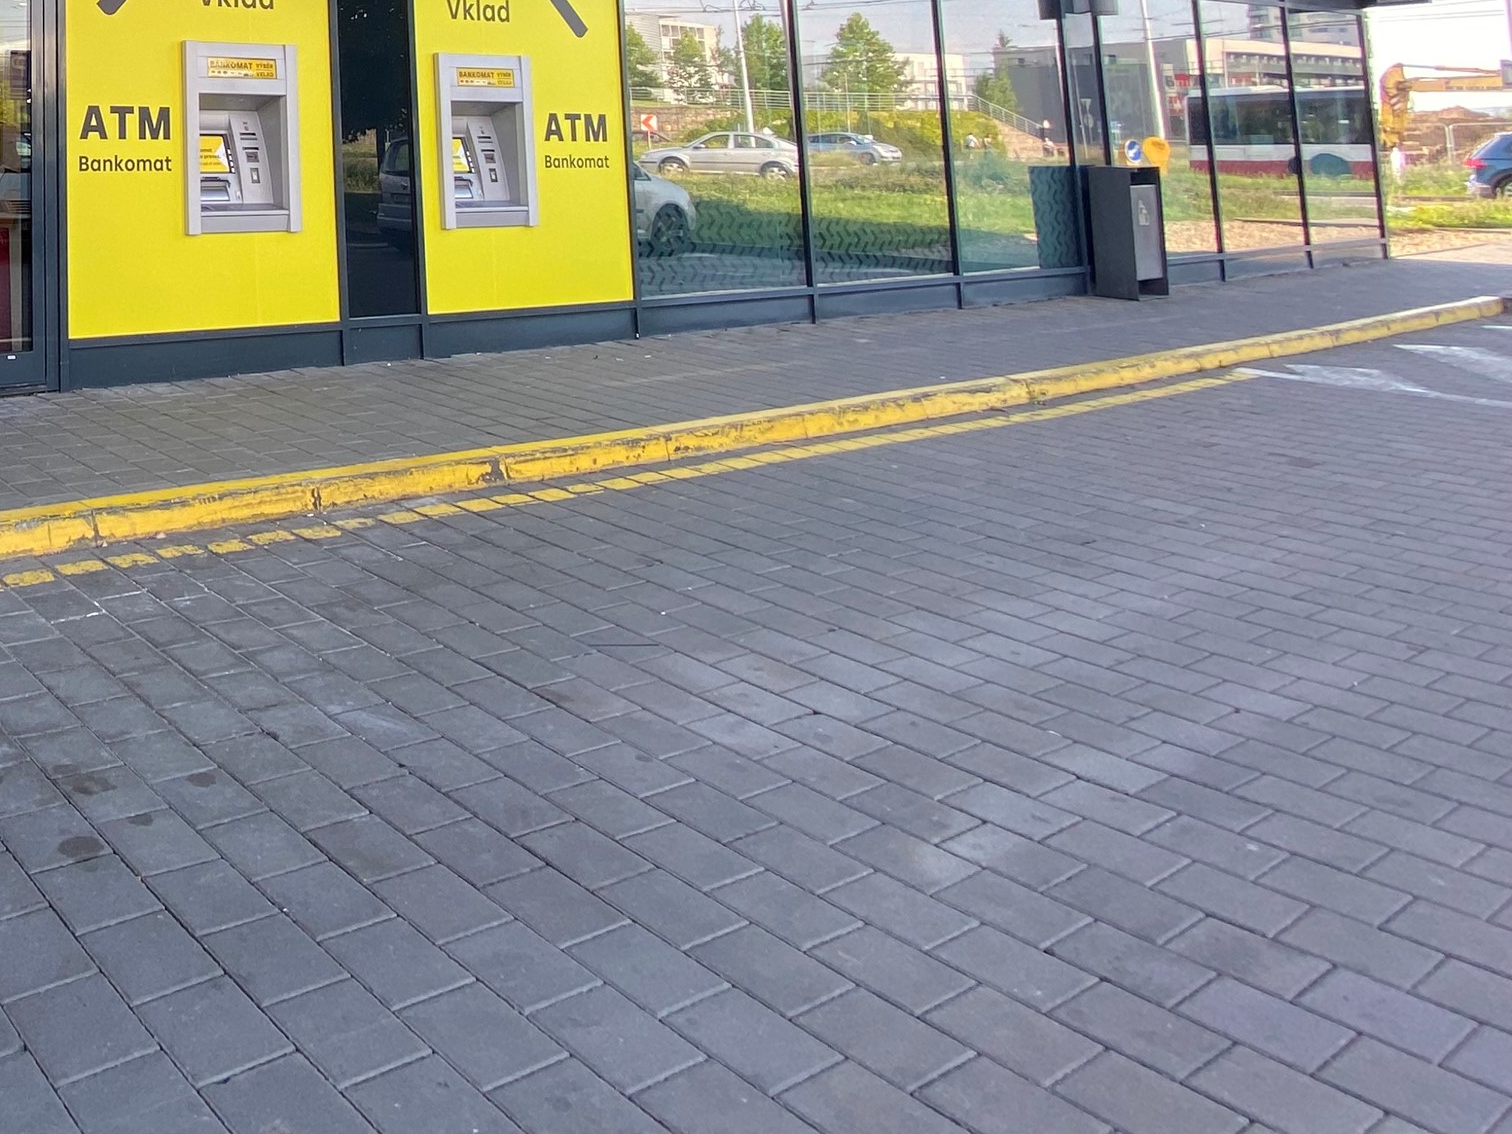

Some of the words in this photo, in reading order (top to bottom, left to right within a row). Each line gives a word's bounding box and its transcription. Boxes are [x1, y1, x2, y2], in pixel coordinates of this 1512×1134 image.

[458, 71, 494, 79] BANKOMAT
[79, 105, 171, 140] ATM
[544, 112, 608, 142] ATM
[78, 154, 173, 172] Bankomat
[544, 154, 610, 169] Bankomat
